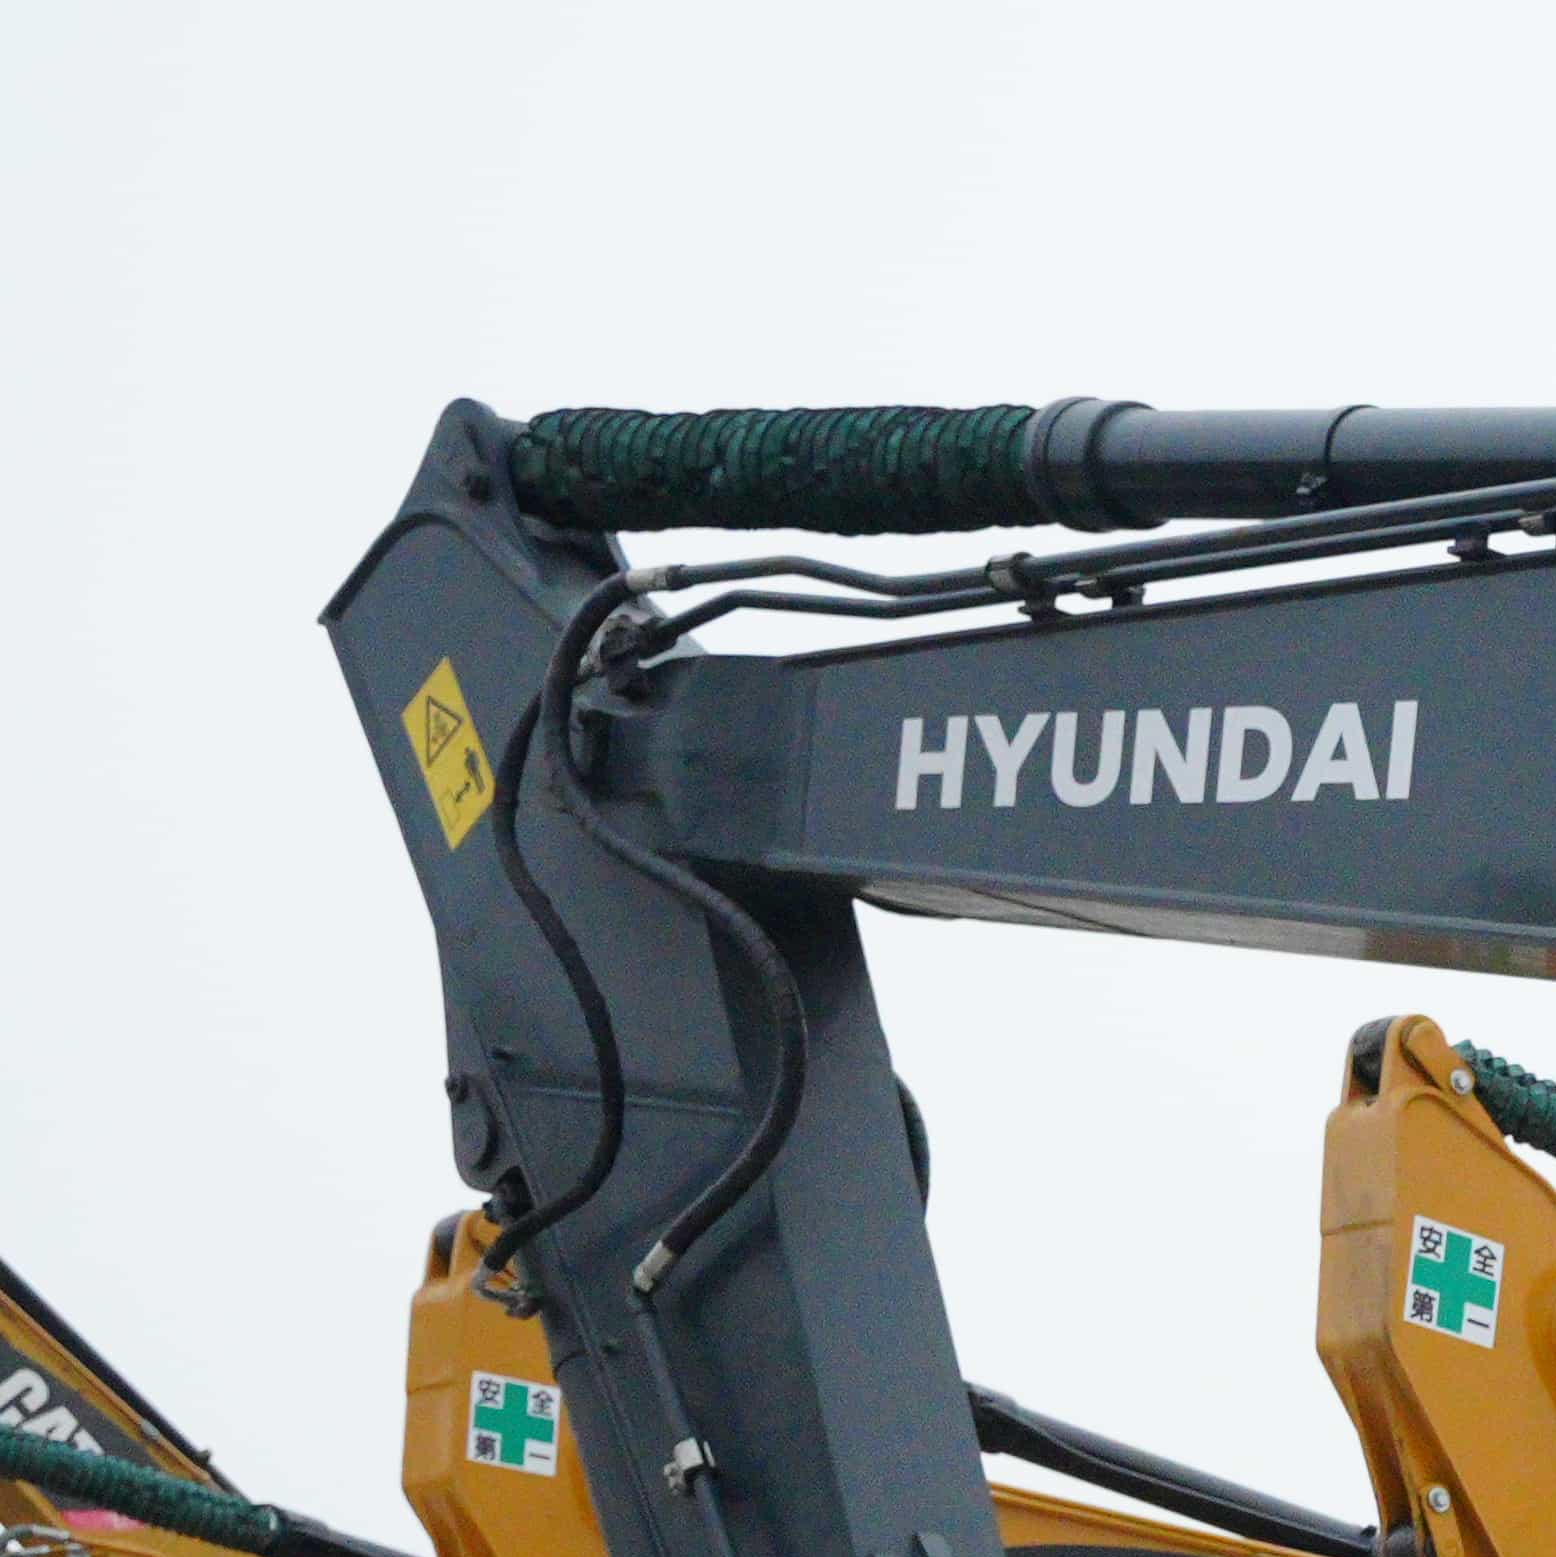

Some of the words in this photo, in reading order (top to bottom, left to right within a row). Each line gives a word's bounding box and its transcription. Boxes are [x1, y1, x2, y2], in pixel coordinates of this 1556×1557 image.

[896, 700, 1418, 790] HYUNDAI
[1418, 1226, 1497, 1277] 安全
[1411, 1289, 1490, 1328] 第一
